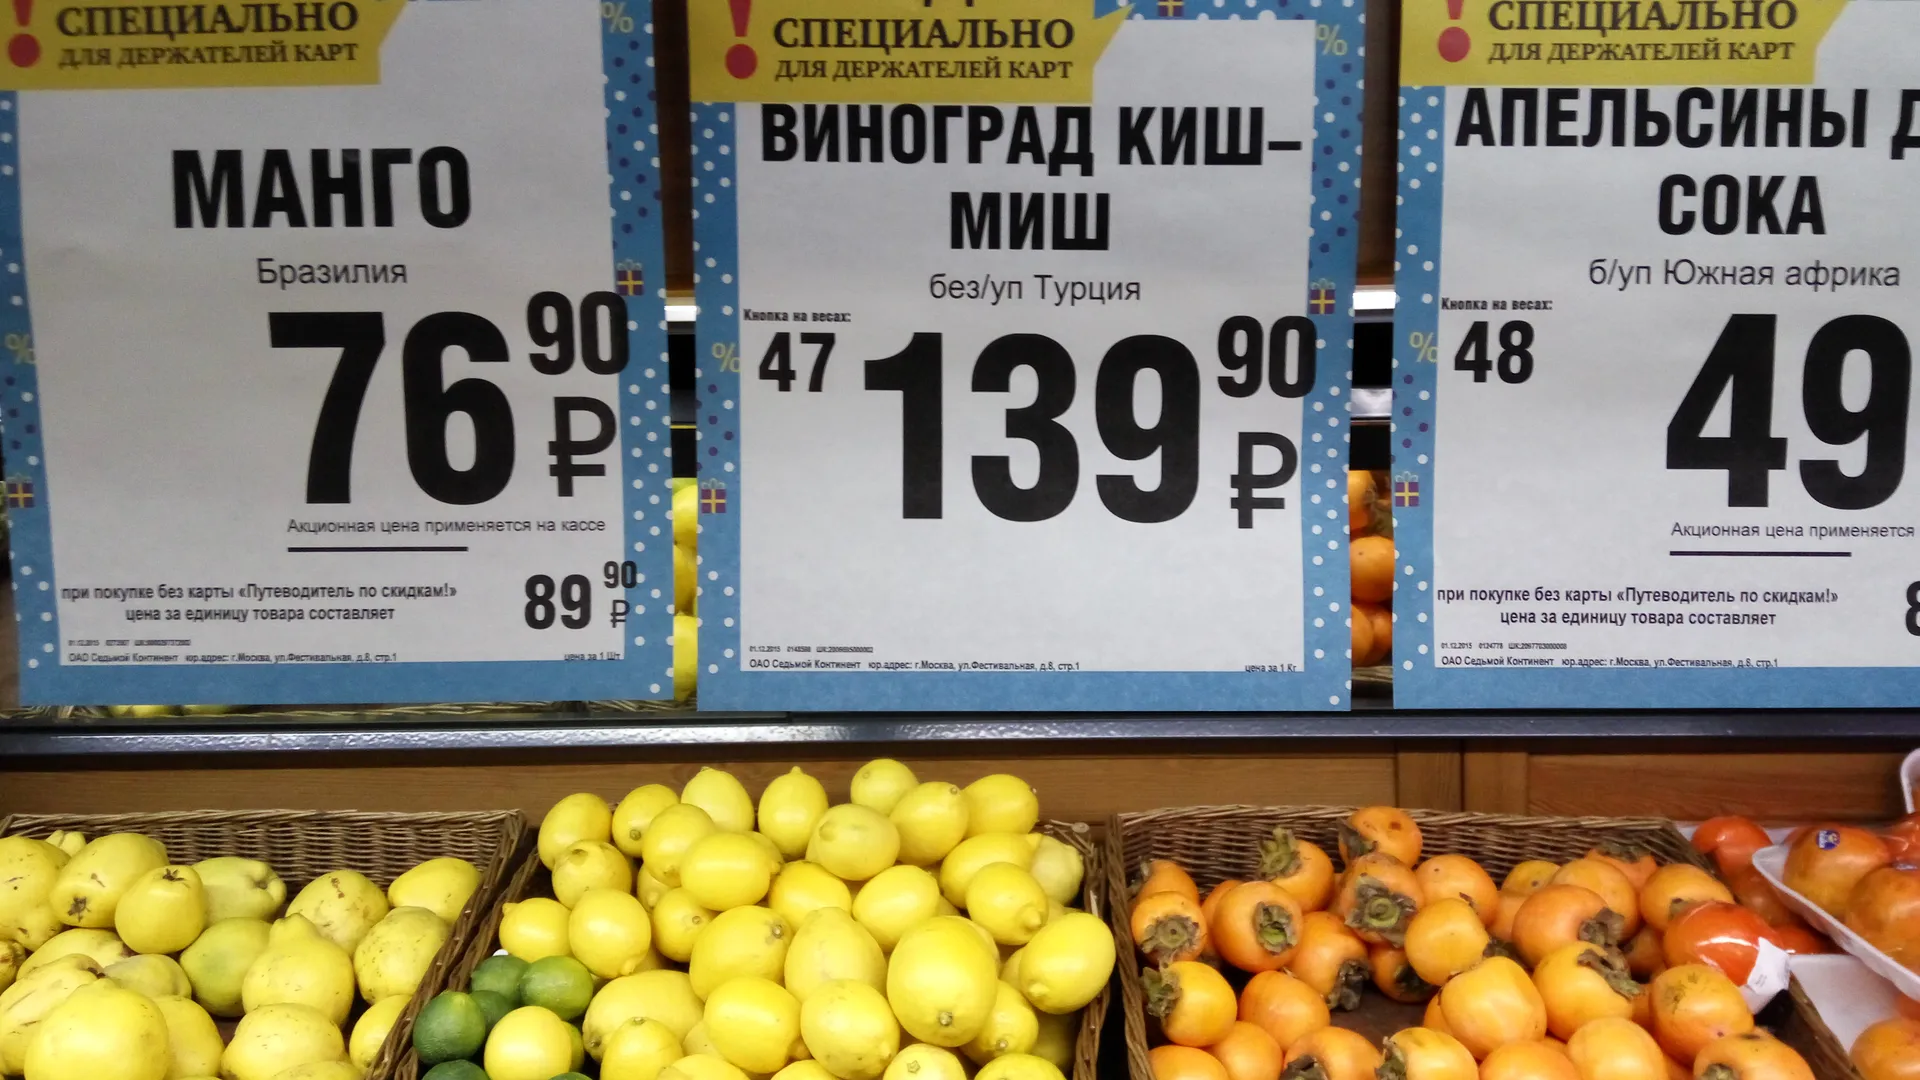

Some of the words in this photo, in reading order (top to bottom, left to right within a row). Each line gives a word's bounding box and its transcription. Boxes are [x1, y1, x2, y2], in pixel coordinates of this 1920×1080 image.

[56, 0, 359, 39] СПЕЦИАЛЬНО
[1489, 0, 1797, 37] СПЕЦИАЛЬНО
[774, 18, 1073, 54] СПЕЦИАЛЬНО
[1488, 43, 1542, 64] ДЛЯ
[1547, 40, 1721, 64] ДЕРЖАТЕЛЕЙ
[1728, 42, 1795, 60] КАРТ
[57, 48, 112, 68] ДЛЯ
[117, 43, 288, 66] ДЕРЖАТЕЛЕЙ
[293, 42, 359, 63] КАРТ
[774, 60, 828, 82] ДЛЯ
[832, 56, 1001, 82] ДЕРЖАТЕЛЕЙ
[1008, 61, 1073, 78] КАРТ
[1455, 88, 1869, 148] АПЕЛЬСИНЫ
[761, 104, 1094, 176] ВИНОГРАД
[173, 146, 470, 228] МАНГО
[1659, 174, 1825, 235] СОКА
[951, 192, 1109, 250] МИШ
[257, 258, 406, 290] Бразилия
[930, 273, 1022, 305] без/уп
[1034, 275, 1140, 306] Турция
[1590, 259, 1651, 291] б/уп
[1665, 259, 1774, 285] Южная
[1785, 260, 1900, 292] африка
[744, 309, 788, 321] Кнопка
[793, 312, 807, 321] на
[812, 313, 851, 322] весах:
[1441, 298, 1488, 310] Кнопка
[1492, 301, 1507, 310] на
[1512, 300, 1552, 310] весах:
[759, 332, 835, 392] 47
[1455, 320, 1534, 384] 48
[268, 312, 515, 505] 76
[527, 290, 631, 374] 90
[1667, 314, 1911, 510] 49
[864, 332, 1200, 523] 139
[1218, 315, 1317, 396] 90
[287, 519, 375, 535] Акционная
[381, 522, 419, 534] цена
[425, 521, 531, 535] применяется
[537, 521, 555, 531] на
[562, 521, 605, 531] кассе
[1671, 522, 1759, 538] Акционная
[1766, 526, 1803, 539] цена
[1810, 526, 1914, 540] применяется
[62, 588, 89, 602] при
[94, 588, 154, 602] покупке
[158, 584, 183, 598] без
[188, 587, 233, 601] карты
[239, 584, 354, 601] «Путеводитель
[359, 587, 377, 597] по
[382, 583, 457, 599] скидкам!»
[525, 574, 591, 629] 89
[604, 560, 637, 587] 90
[1438, 590, 1464, 604] при
[1470, 590, 1530, 604] покупке
[1535, 587, 1560, 601] без
[1566, 590, 1611, 605] карты
[1617, 587, 1735, 605] «Путеводитель
[1741, 592, 1758, 602] по
[1763, 589, 1838, 605] скидкам!»
[126, 609, 160, 622] цена
[165, 609, 180, 620] за
[185, 609, 249, 622] единицу
[252, 609, 304, 622] товара
[309, 609, 395, 620] составляет
[1501, 612, 1536, 625] цена
[1541, 613, 1557, 623] за
[1562, 613, 1626, 626] единицу
[1631, 613, 1683, 626] товара
[1689, 614, 1776, 624] составляет
[133, 653, 178, 662] Континент
[564, 652, 585, 661] цена
[749, 659, 770, 669] ОАО
[772, 659, 812, 670] Седьмой
[815, 659, 861, 669] Континент
[868, 660, 912, 671] юр.адрес:
[915, 661, 954, 671] г.Москва,
[1058, 662, 1079, 673] стр.1
[1245, 664, 1266, 673] цена
[1441, 656, 1462, 666] ОАО
[1464, 655, 1504, 667] Седьмой
[1507, 656, 1554, 667] Континент
[1562, 658, 1607, 668] юр.адрес:
[1610, 658, 1651, 668] г.Москва,
[1756, 659, 1778, 670] стр.1
